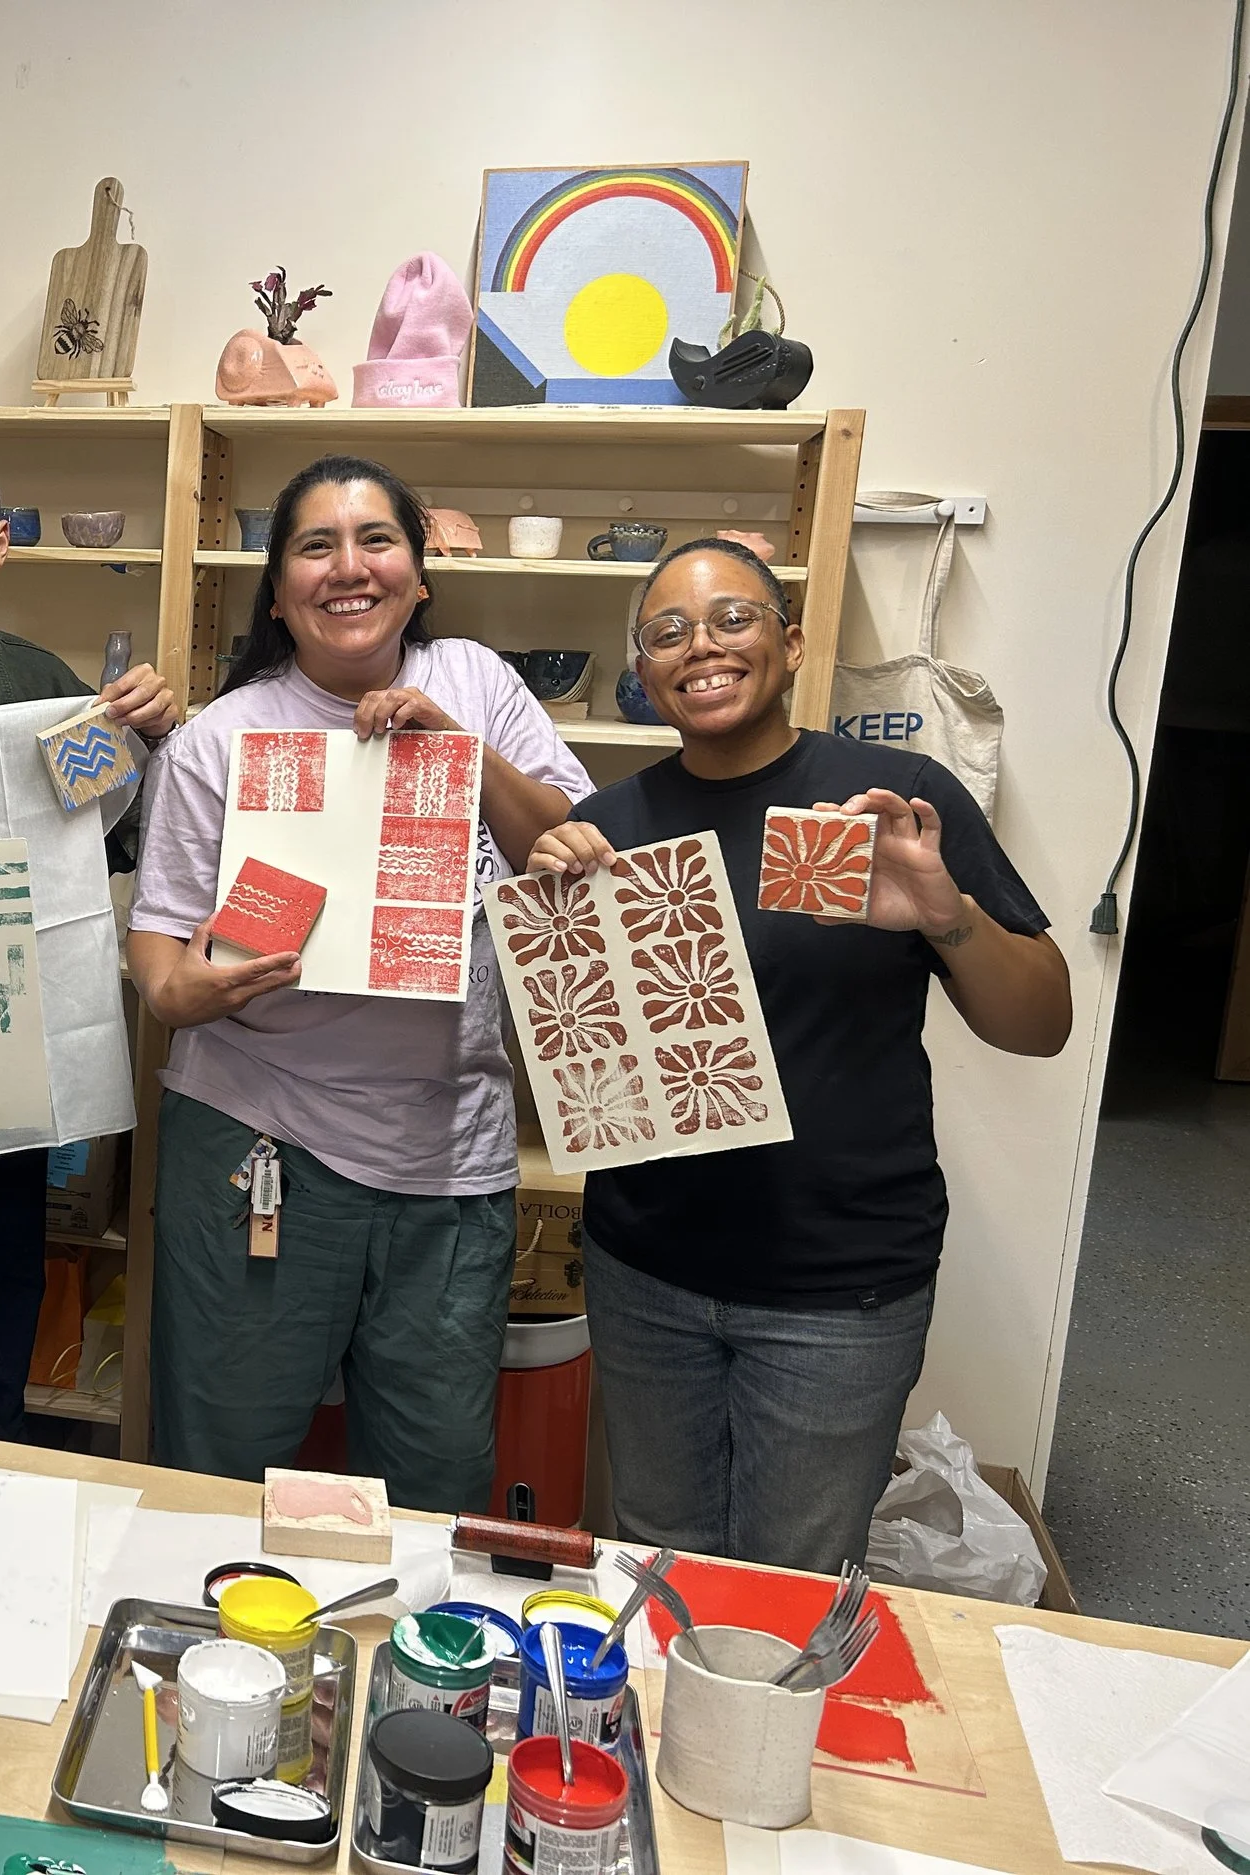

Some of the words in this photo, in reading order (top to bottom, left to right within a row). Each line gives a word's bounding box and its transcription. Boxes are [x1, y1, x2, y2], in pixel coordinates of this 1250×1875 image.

[834, 712, 924, 741] KEEP
[519, 1202, 581, 1220] BOLLA
[514, 1288, 568, 1301] Selection
